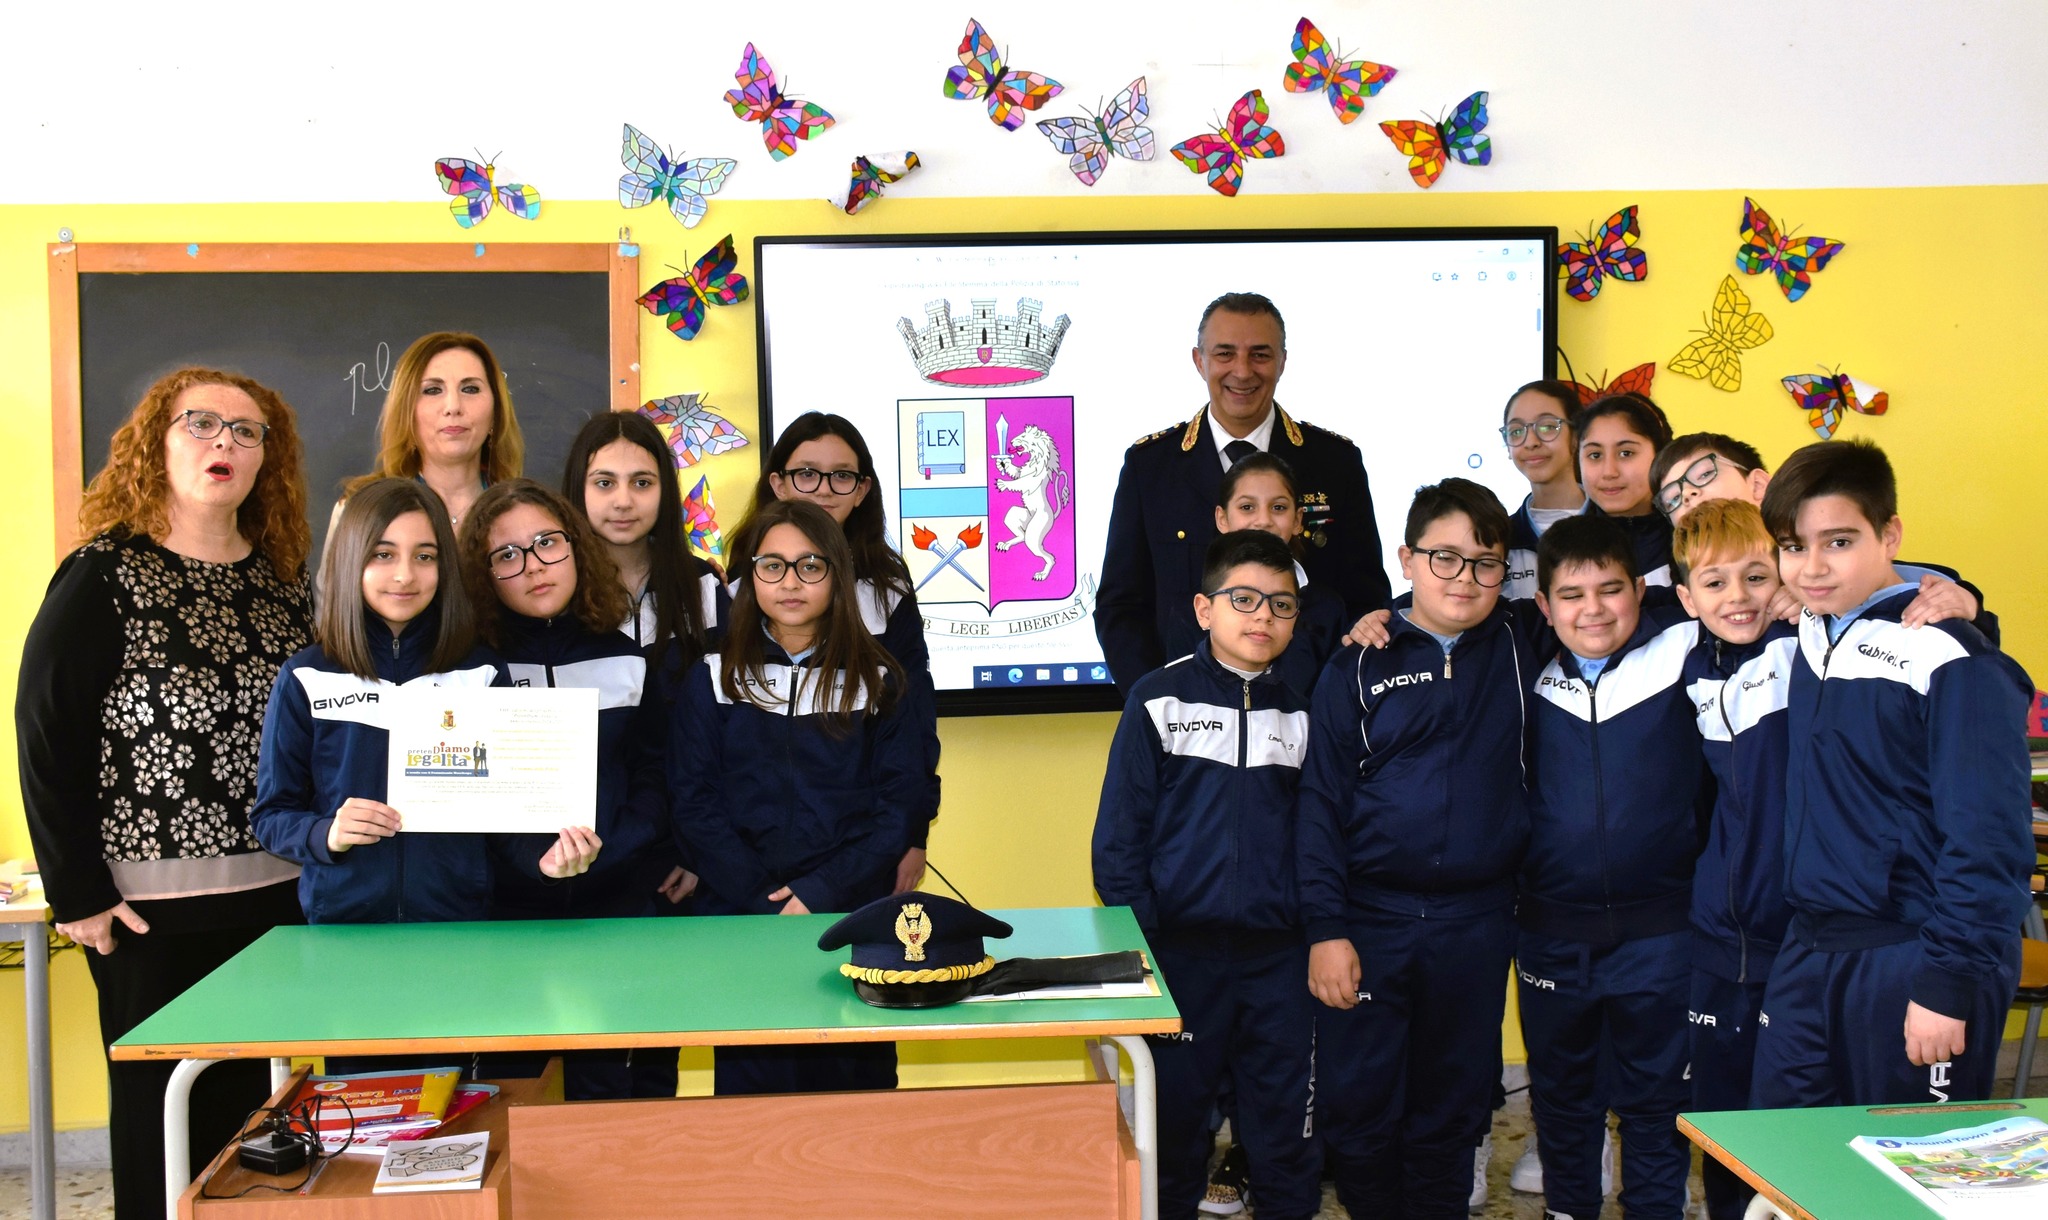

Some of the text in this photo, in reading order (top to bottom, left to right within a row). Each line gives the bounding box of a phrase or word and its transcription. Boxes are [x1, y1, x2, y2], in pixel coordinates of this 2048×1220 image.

[927, 429, 960, 447] LEX
[950, 622, 990, 636] LEGE
[1008, 607, 1079, 634] LIBERTAS
[313, 692, 379, 711] GIVOVA
[1167, 719, 1223, 733] GIVOVA
[1905, 1138, 1951, 1147] Around
[1952, 1131, 1990, 1143] Town
